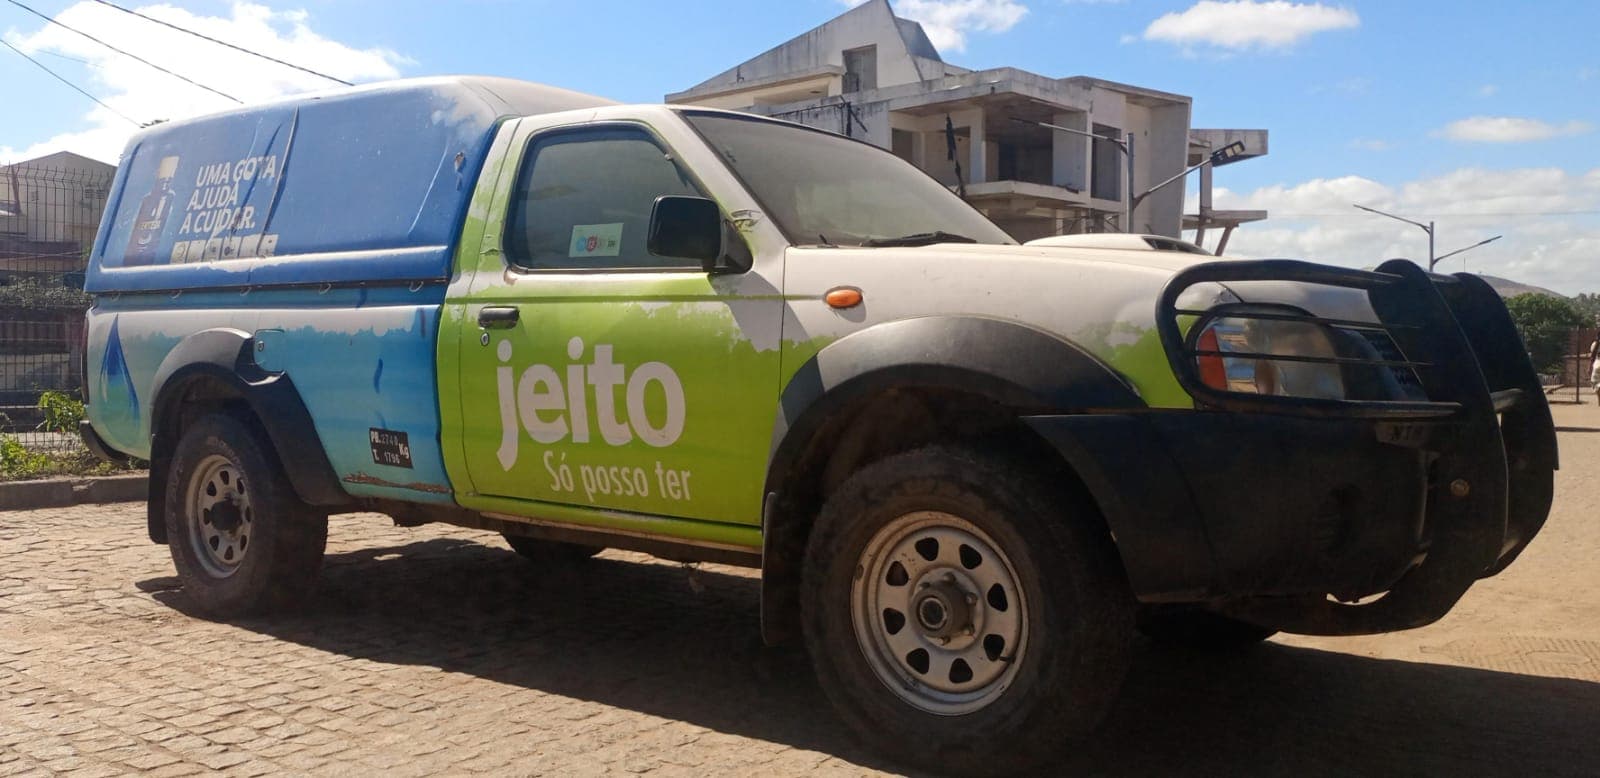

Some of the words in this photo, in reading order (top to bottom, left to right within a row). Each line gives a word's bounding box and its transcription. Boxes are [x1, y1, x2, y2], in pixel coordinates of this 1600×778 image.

[196, 161, 231, 187] UMA
[186, 182, 238, 211] AJUDA
[179, 211, 191, 235] A
[496, 336, 686, 472] jeito
[398, 442, 410, 460] Kg
[543, 450, 575, 492] Só
[580, 464, 649, 503] posso
[655, 460, 691, 500] ter
